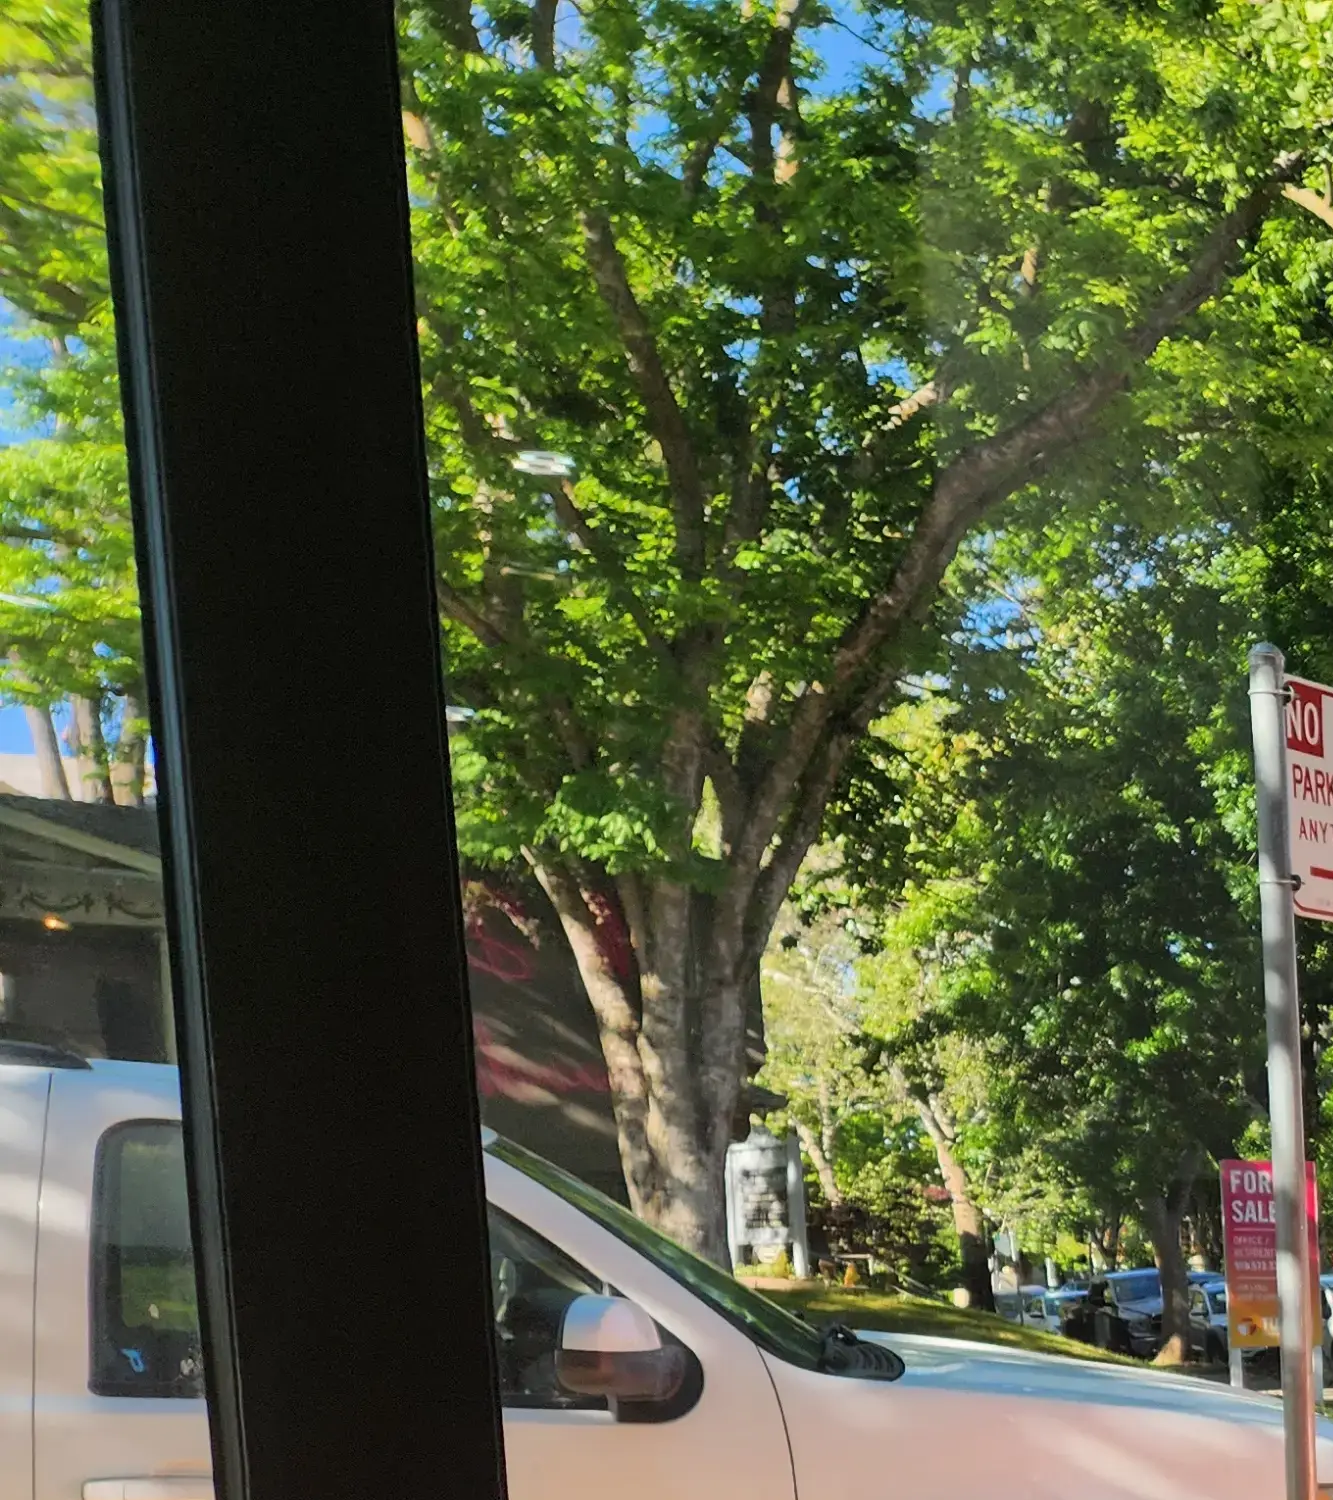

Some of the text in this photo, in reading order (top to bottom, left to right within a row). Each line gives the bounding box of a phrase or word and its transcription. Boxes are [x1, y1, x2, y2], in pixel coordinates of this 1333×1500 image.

[1286, 699, 1320, 746] NO
[1229, 1168, 1272, 1195] FOR
[1231, 1199, 1276, 1224] SALE
